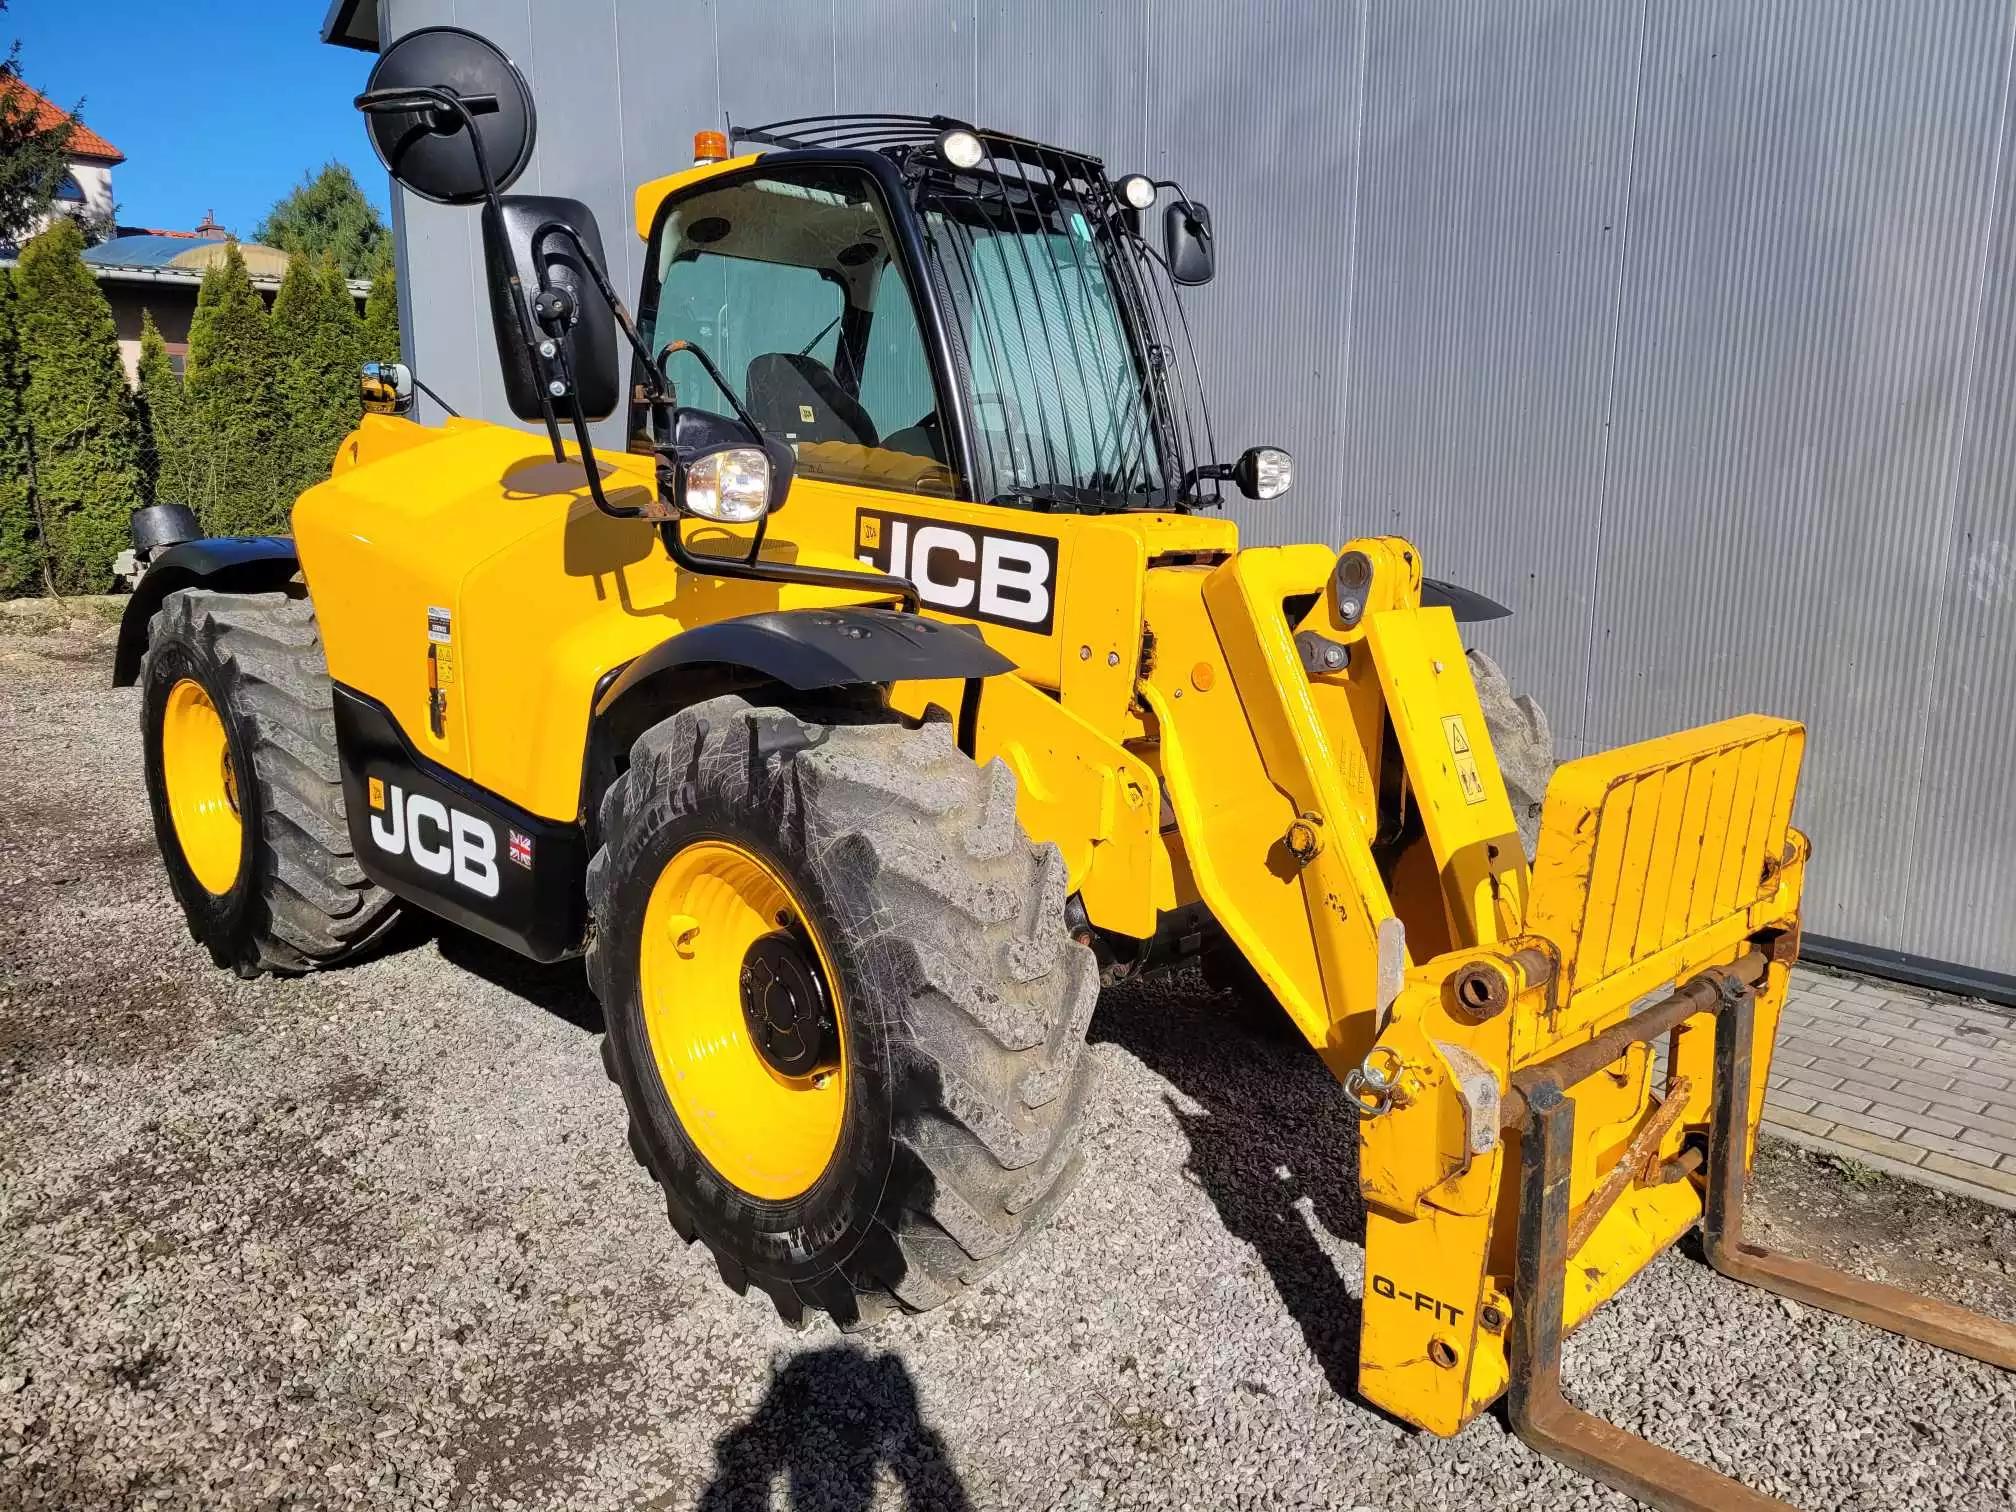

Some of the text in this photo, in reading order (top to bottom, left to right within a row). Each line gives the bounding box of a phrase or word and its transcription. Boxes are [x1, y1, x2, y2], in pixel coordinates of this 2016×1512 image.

[859, 521, 1050, 623] JCB
[370, 785, 499, 897] JCB
[1373, 1274, 1464, 1327] Q-FIT
